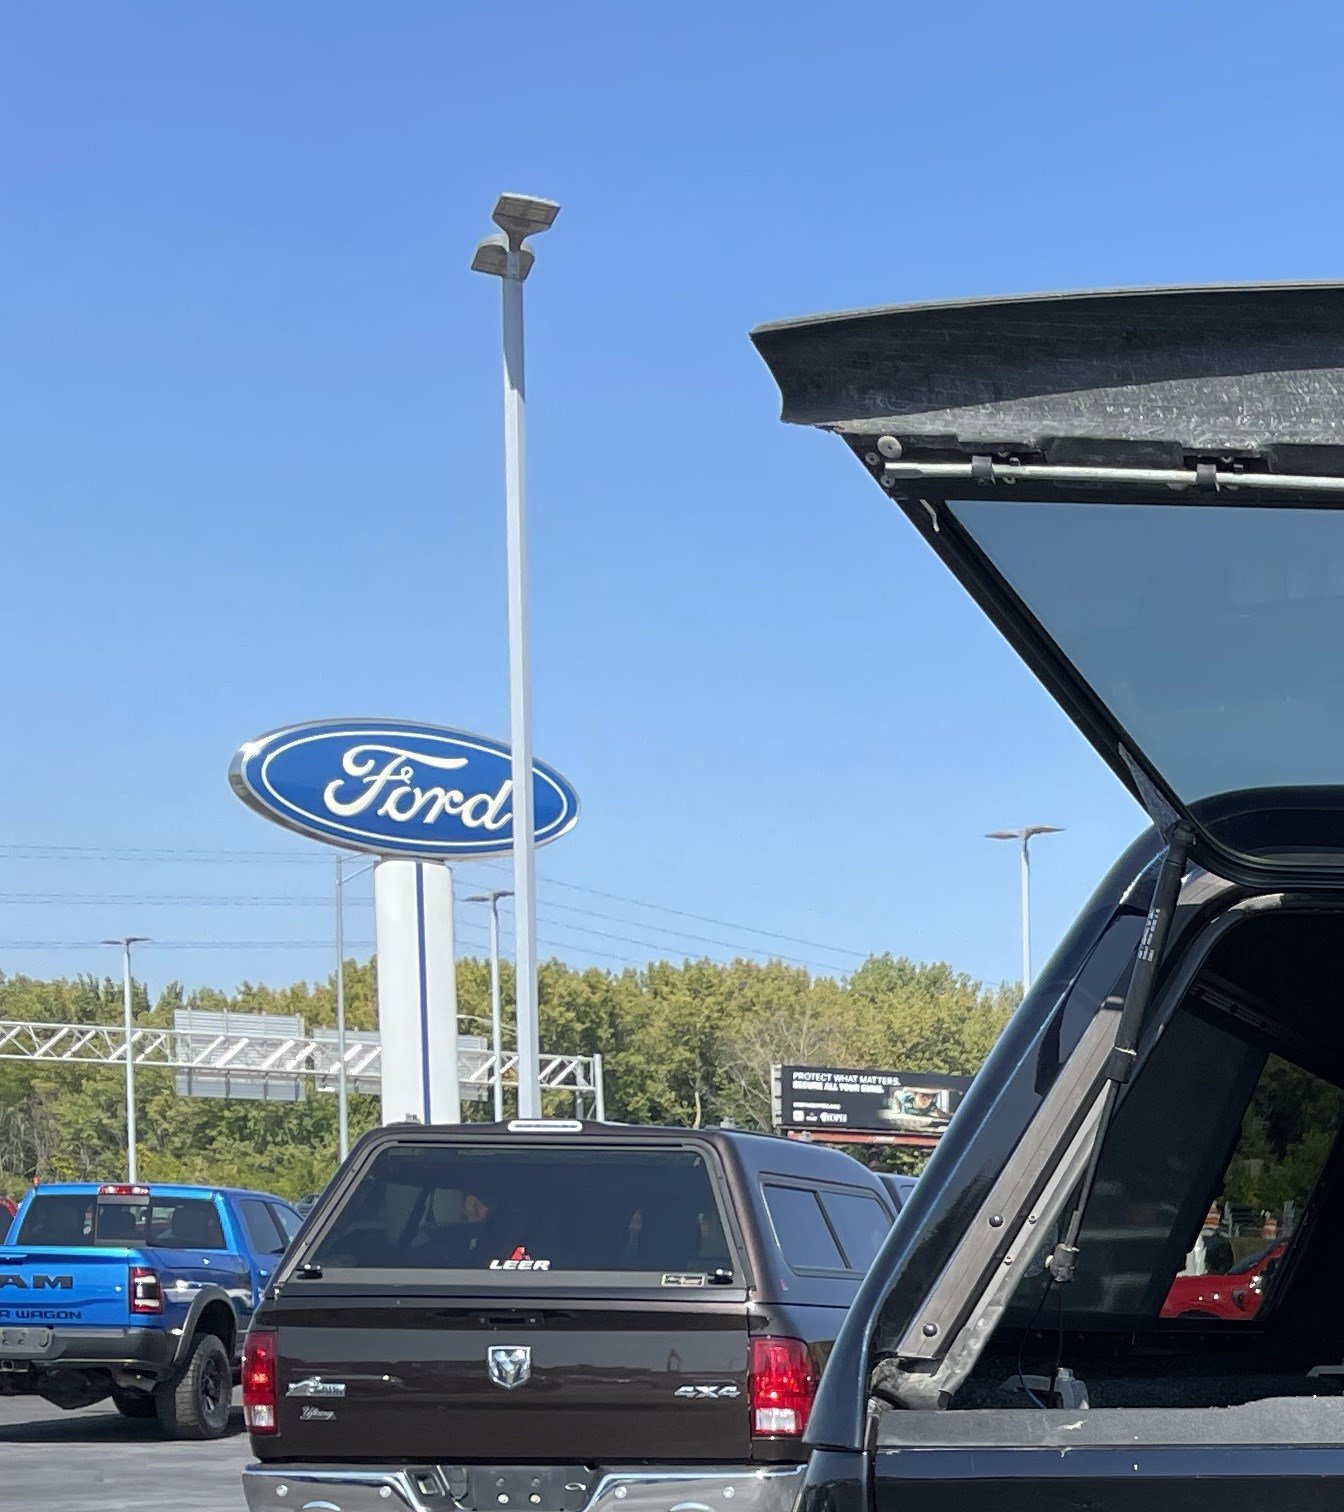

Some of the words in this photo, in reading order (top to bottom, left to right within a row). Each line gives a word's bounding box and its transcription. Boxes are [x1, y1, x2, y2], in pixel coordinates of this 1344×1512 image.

[323, 744, 514, 831] Ford
[792, 1071, 832, 1082] PROTECT
[833, 1074, 858, 1083] WHAT
[489, 1259, 551, 1271] LEER
[15, 1310, 82, 1320] WAGON
